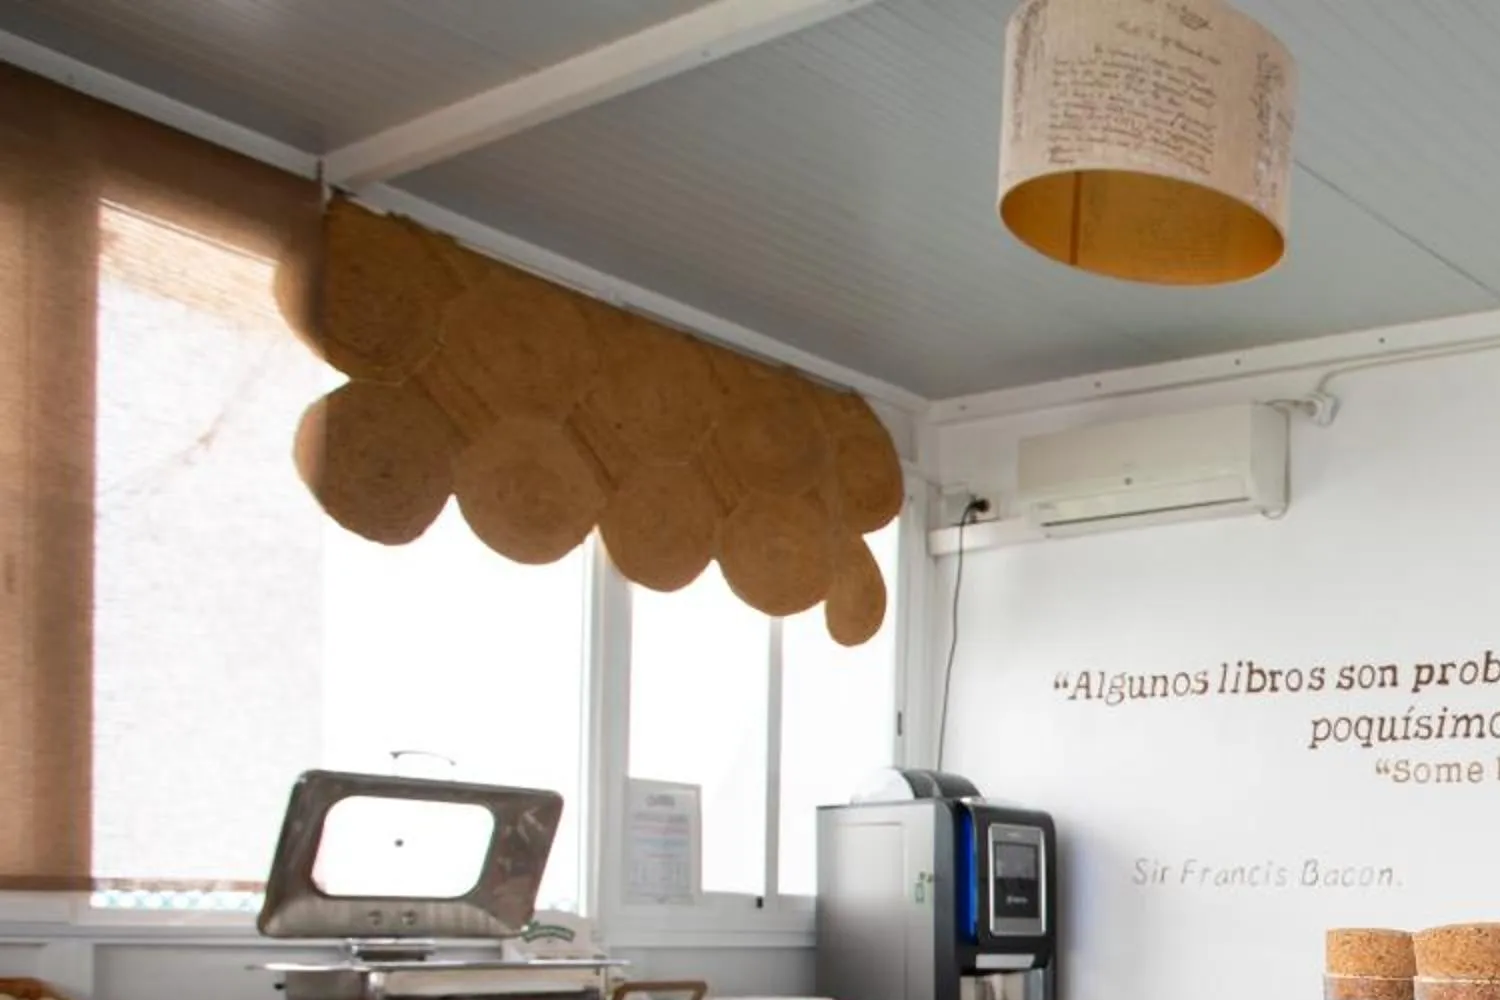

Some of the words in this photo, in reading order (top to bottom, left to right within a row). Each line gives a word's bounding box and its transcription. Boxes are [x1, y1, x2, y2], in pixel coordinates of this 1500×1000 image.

[1217, 660, 1327, 695] libros
[1334, 663, 1400, 692] son
[1131, 856, 1171, 887] Sir
[1179, 858, 1289, 888] Francis
[1299, 857, 1405, 889] Bacon.
